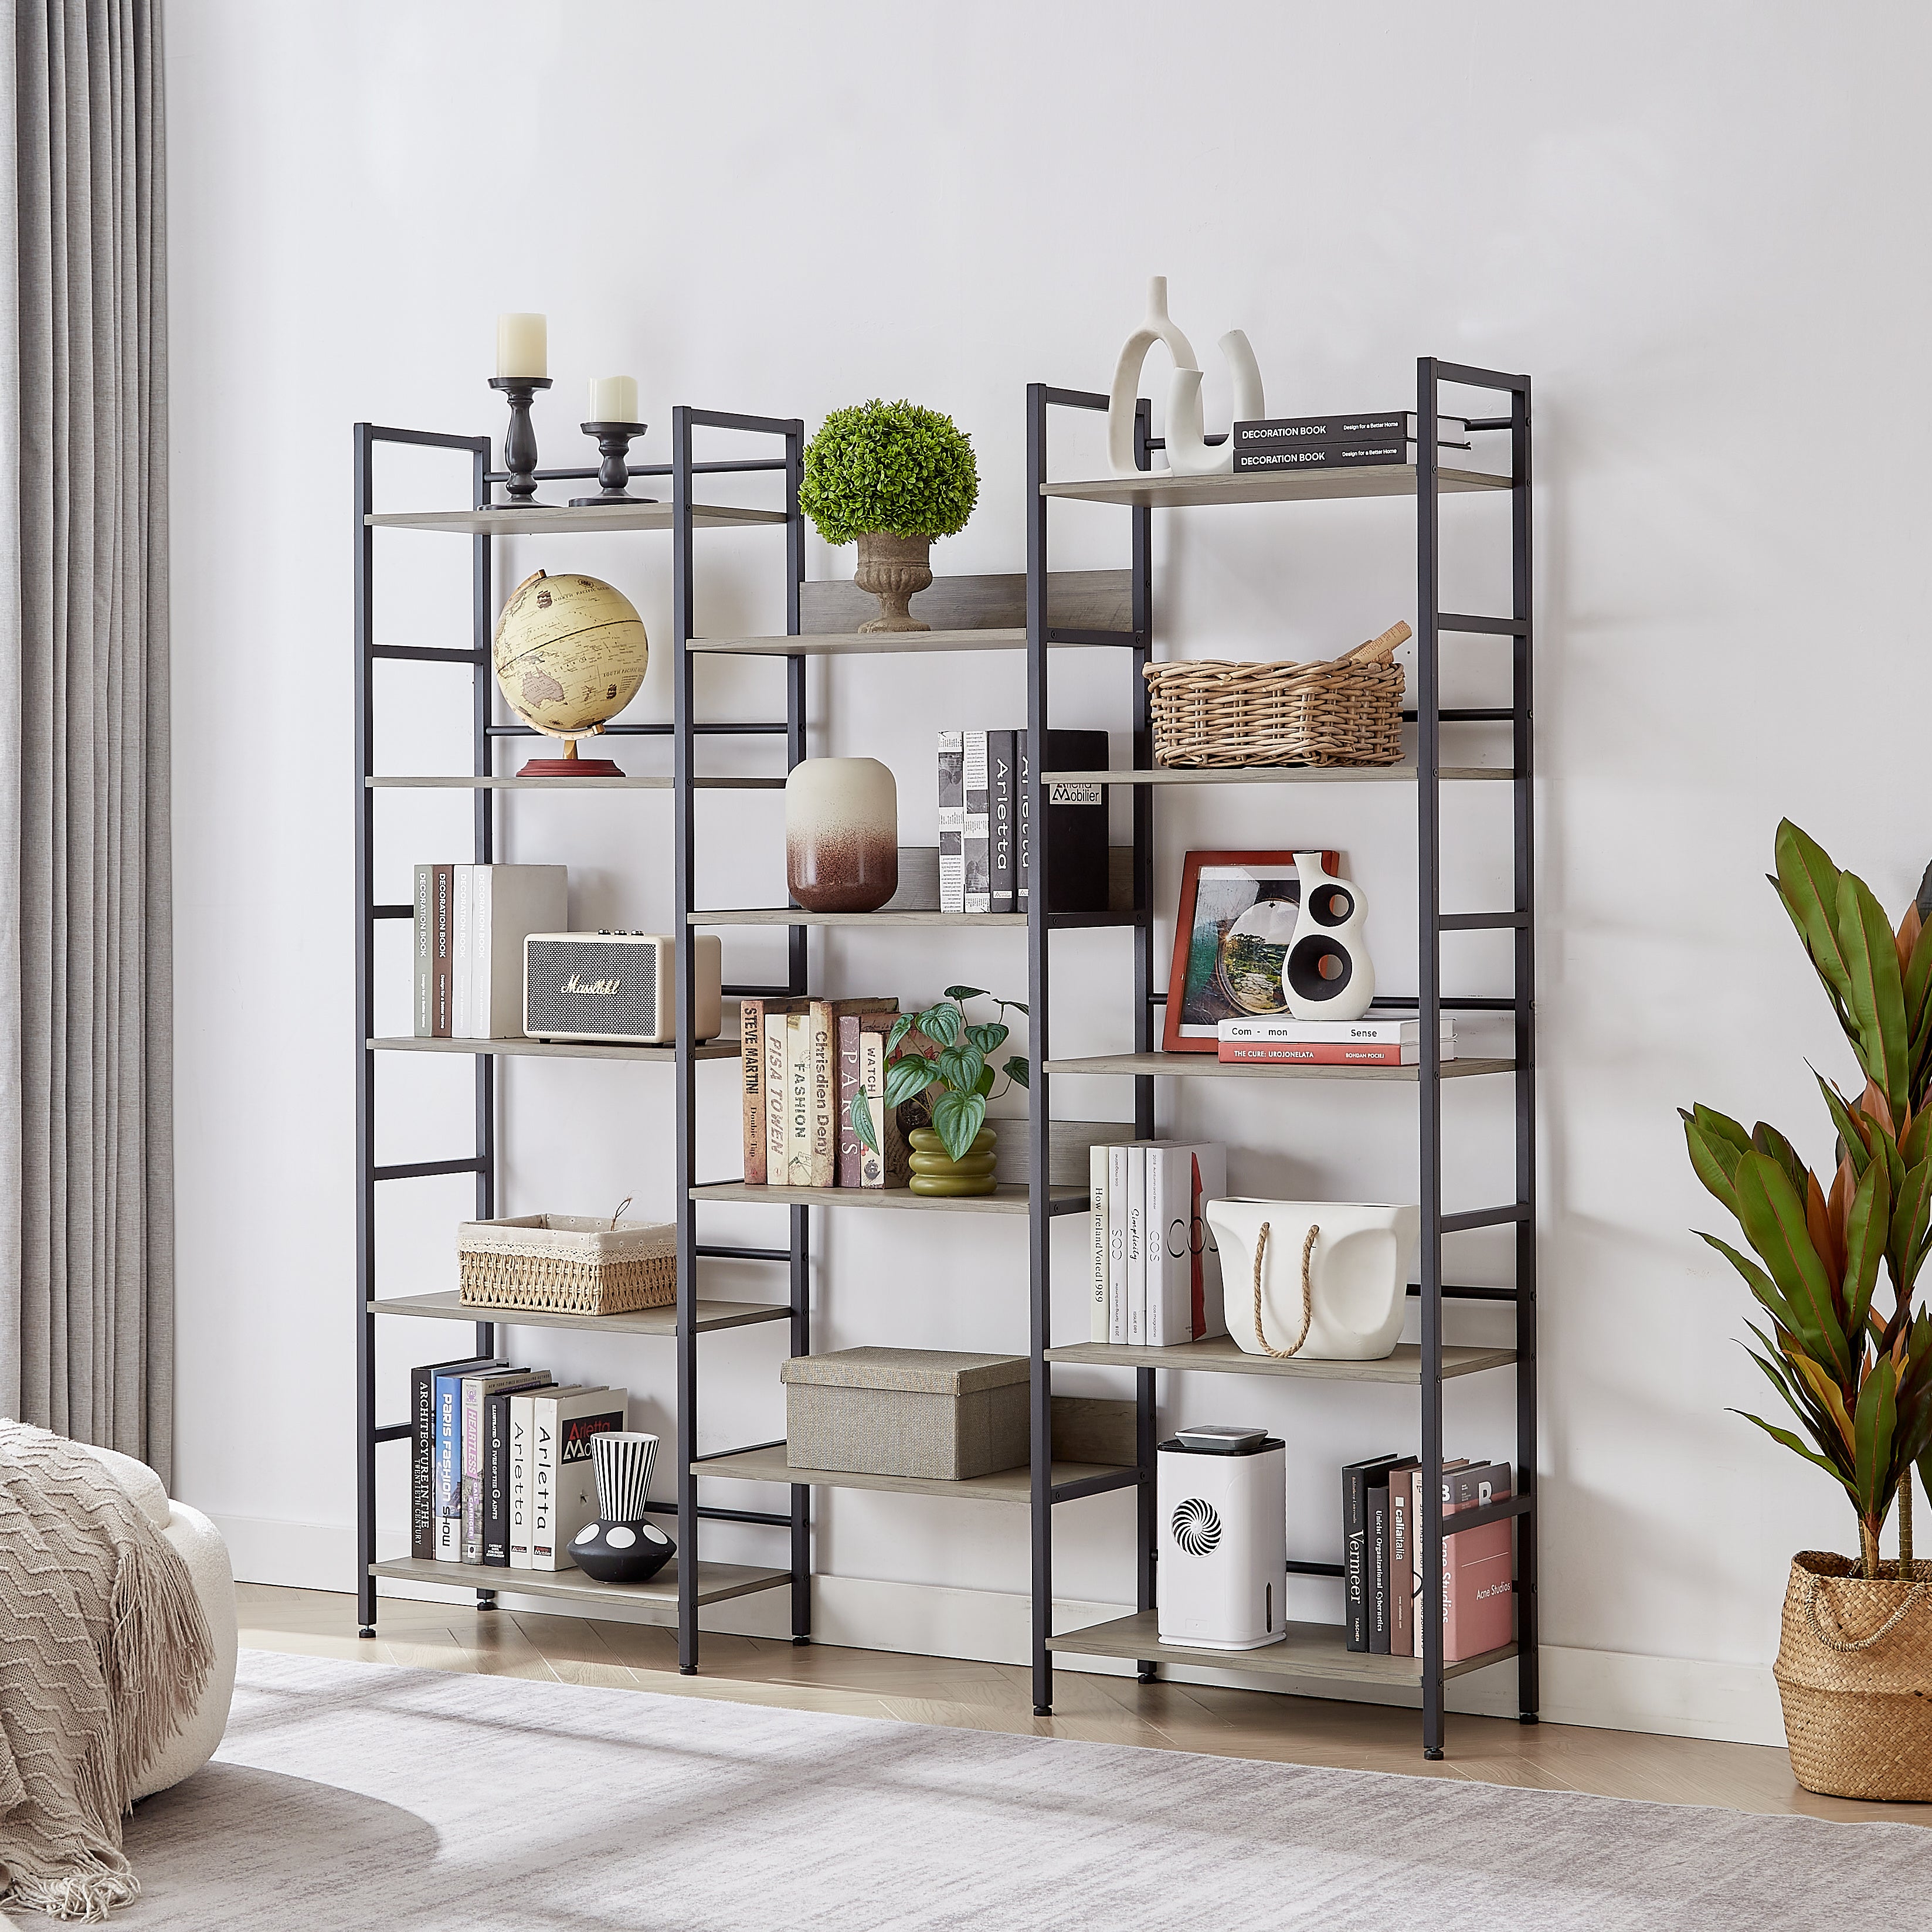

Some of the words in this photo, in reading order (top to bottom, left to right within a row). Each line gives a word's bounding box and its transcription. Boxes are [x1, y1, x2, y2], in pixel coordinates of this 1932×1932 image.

[1242, 427, 1298, 439] DECORATION
[1300, 425, 1326, 435] BOOK
[1241, 454, 1298, 466] DECORATION
[1299, 451, 1325, 461] BOOK
[603, 669, 621, 677] SOUTH
[997, 758, 1009, 870] Arletta
[1052, 788, 1099, 802] Mobilier
[744, 1008, 758, 1044] STEVE
[1232, 1027, 1252, 1035] Com
[1350, 1029, 1377, 1037] Sense
[745, 1048, 759, 1094] MARTINI
[769, 1035, 782, 1080] PISA
[815, 1031, 829, 1109] Chrisdien
[867, 1047, 876, 1092] WATCH
[794, 1064, 806, 1138] FASHION
[814, 1114, 829, 1156] Deny
[1112, 1228, 1122, 1261] COS
[1130, 1208, 1140, 1262] Simplicity
[1150, 1231, 1160, 1262] COS
[1167, 1215, 1218, 1258] CO
[420, 1381, 429, 1482] ARCHITECYURE
[468, 1410, 477, 1475] HEARTLESS
[569, 1420, 610, 1441] Arletta
[420, 1484, 429, 1500] IN
[515, 1421, 524, 1525] Arletta
[537, 1426, 551, 1529] Arletta
[420, 1502, 429, 1529] THE
[1395, 1509, 1405, 1560] caliaitalia
[1349, 1529, 1364, 1604] Vermeer
[1375, 1537, 1383, 1588] Organizational
[1376, 1591, 1384, 1632] Cybernetics
[1442, 1572, 1452, 1624] Studios
[1476, 1588, 1490, 1600] Acne
[1491, 1581, 1510, 1595] Studios
